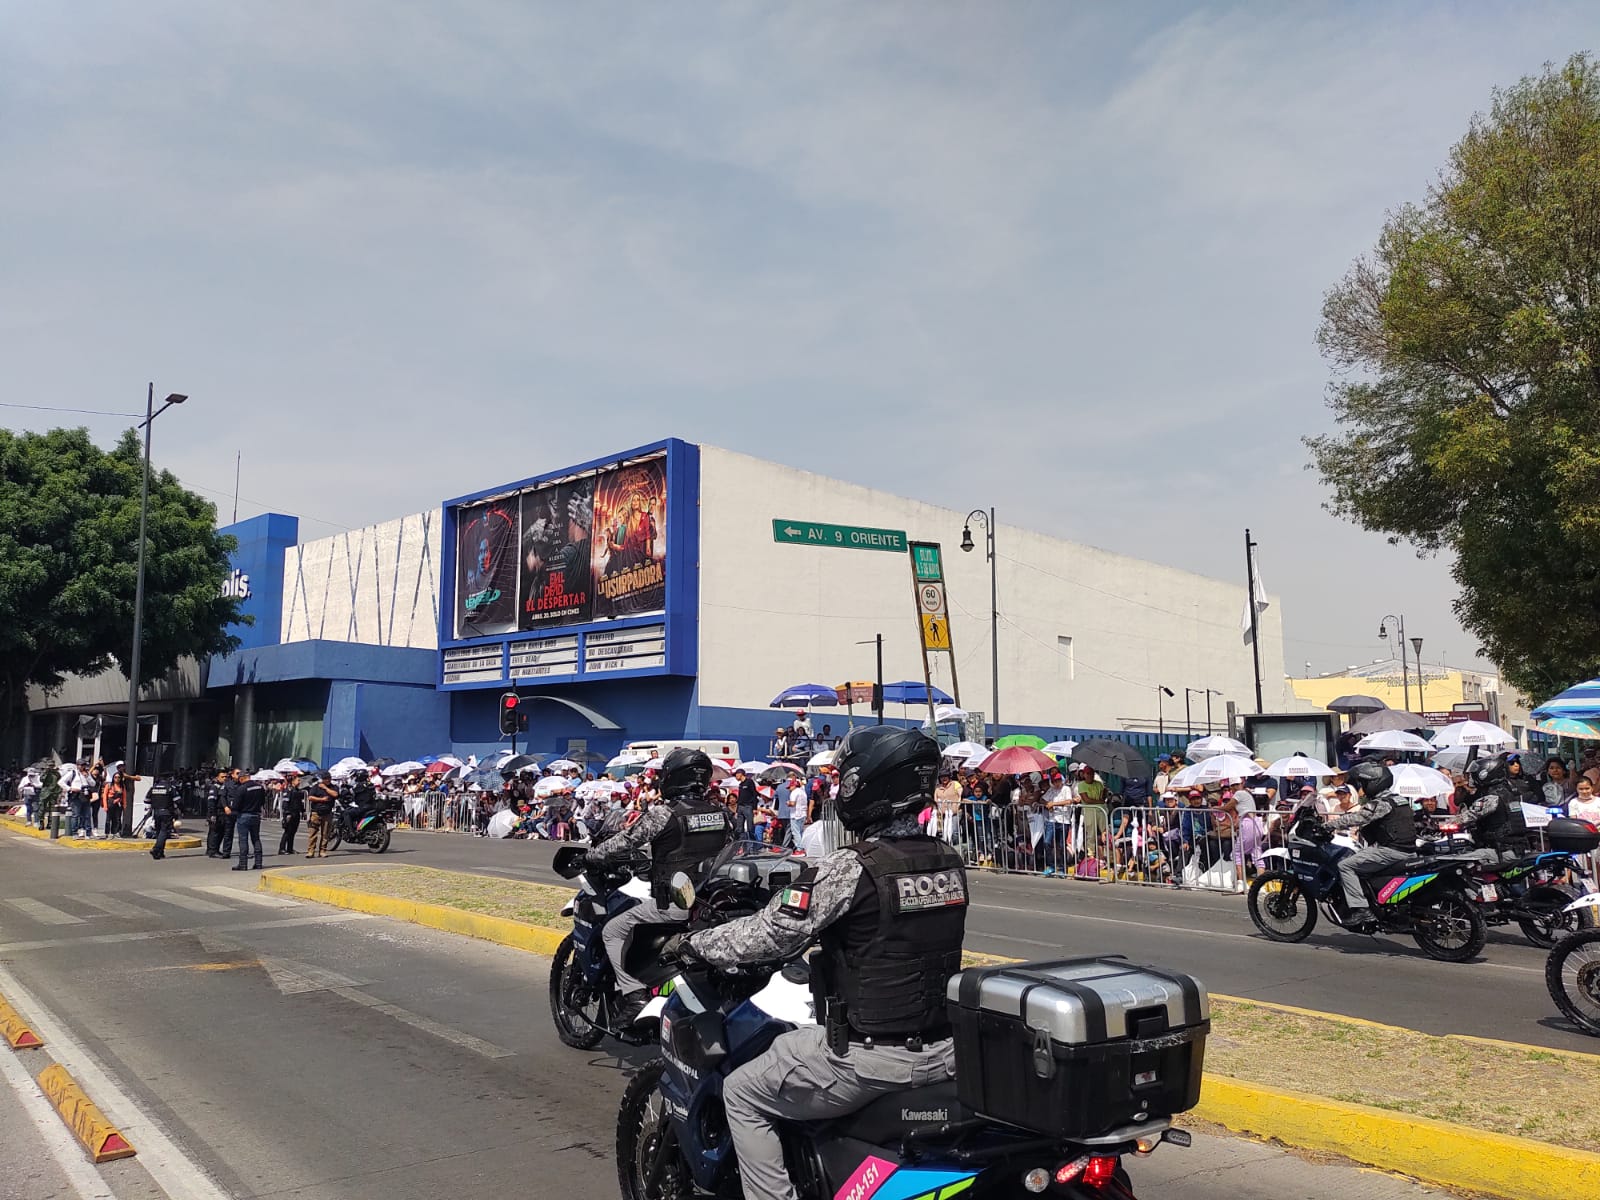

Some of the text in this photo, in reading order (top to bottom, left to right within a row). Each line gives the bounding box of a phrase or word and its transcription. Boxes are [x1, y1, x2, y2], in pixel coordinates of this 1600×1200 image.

[807, 528, 900, 547] AV. 9 ORIENTE
[605, 562, 663, 599] USURPADORA
[537, 592, 586, 611] DESPERTAR
[925, 589, 935, 598] 60
[896, 872, 964, 898] ROCA
[901, 1108, 948, 1121] Kawasaki
